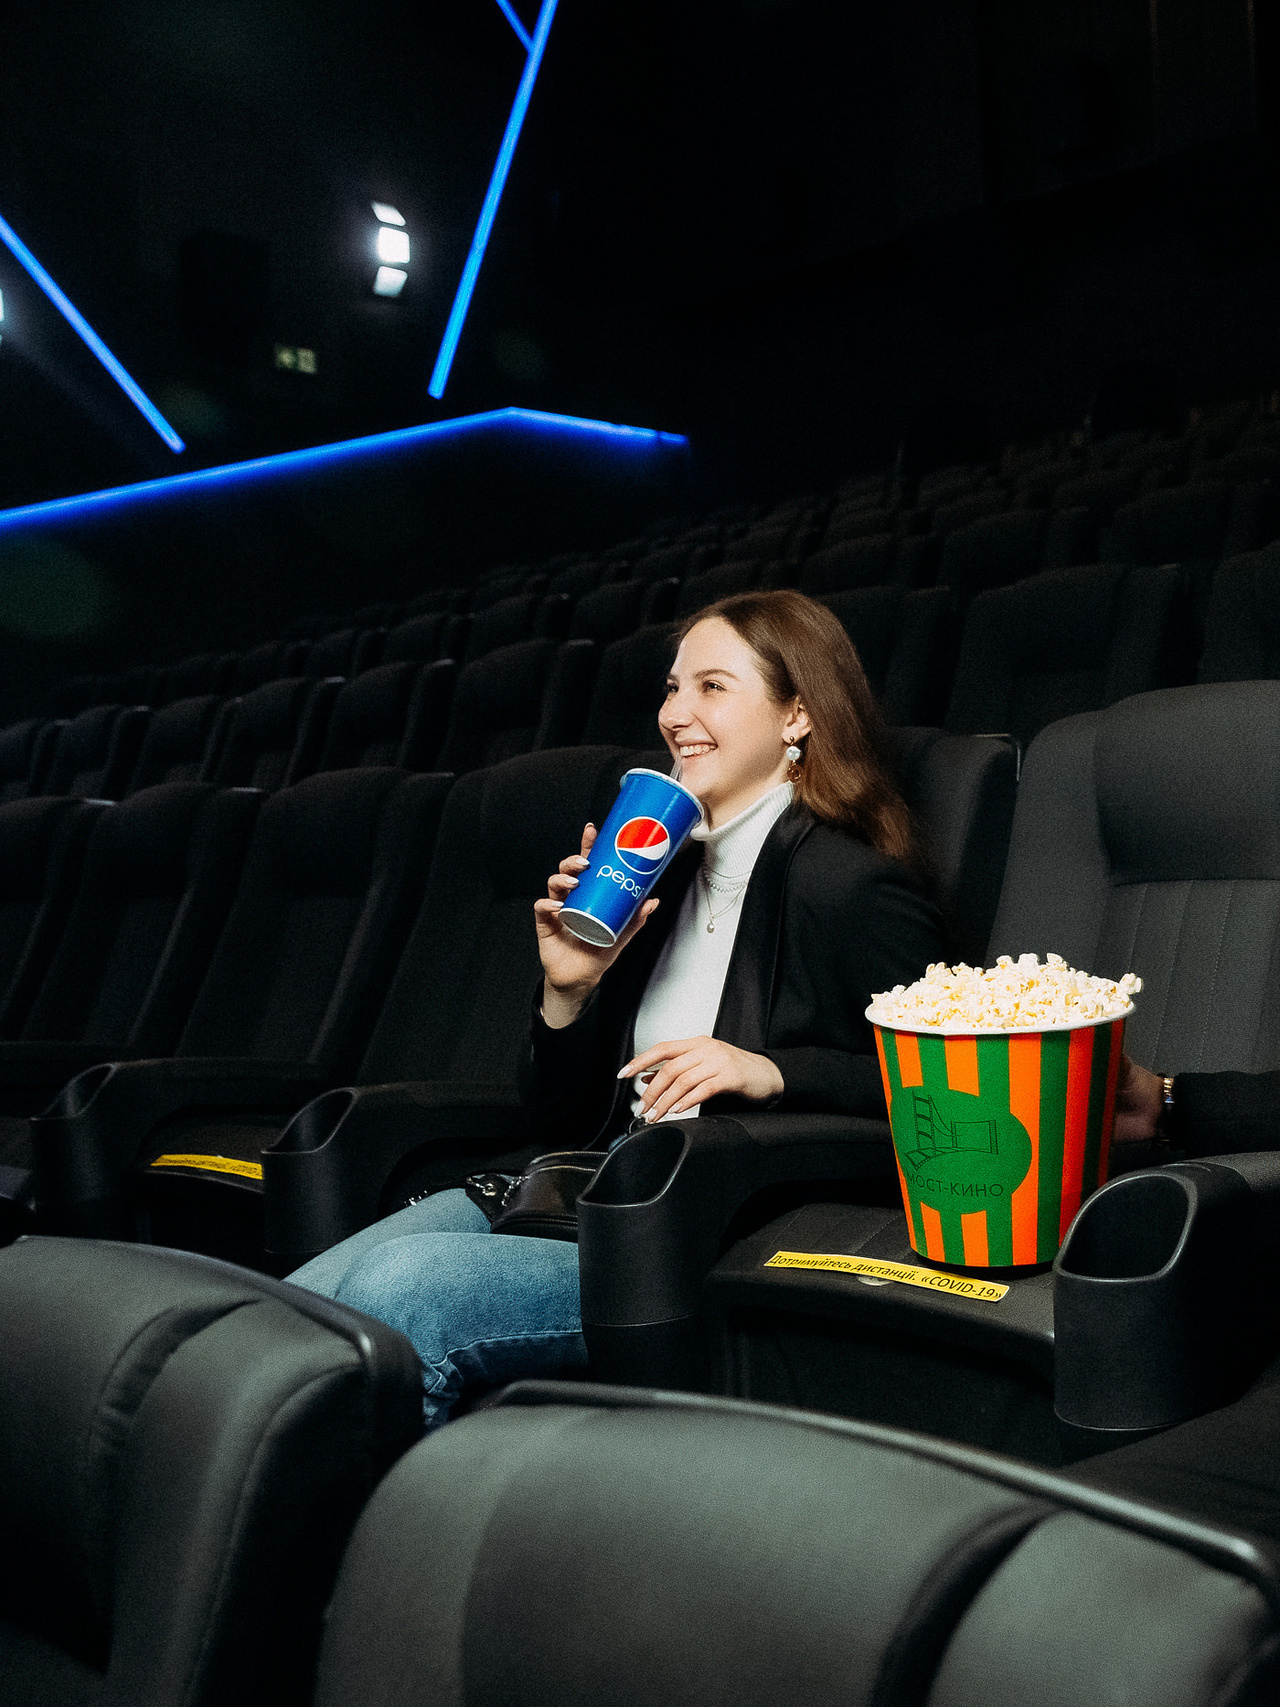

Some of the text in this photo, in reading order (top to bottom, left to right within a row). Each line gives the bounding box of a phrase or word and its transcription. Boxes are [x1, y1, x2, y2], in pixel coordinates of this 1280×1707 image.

[597, 865, 645, 899] pepsi
[906, 1169, 1004, 1197] МОСТ-КИНО
[767, 1255, 1002, 1298] Дотримуйтесь дистанції. «COVID-19»
